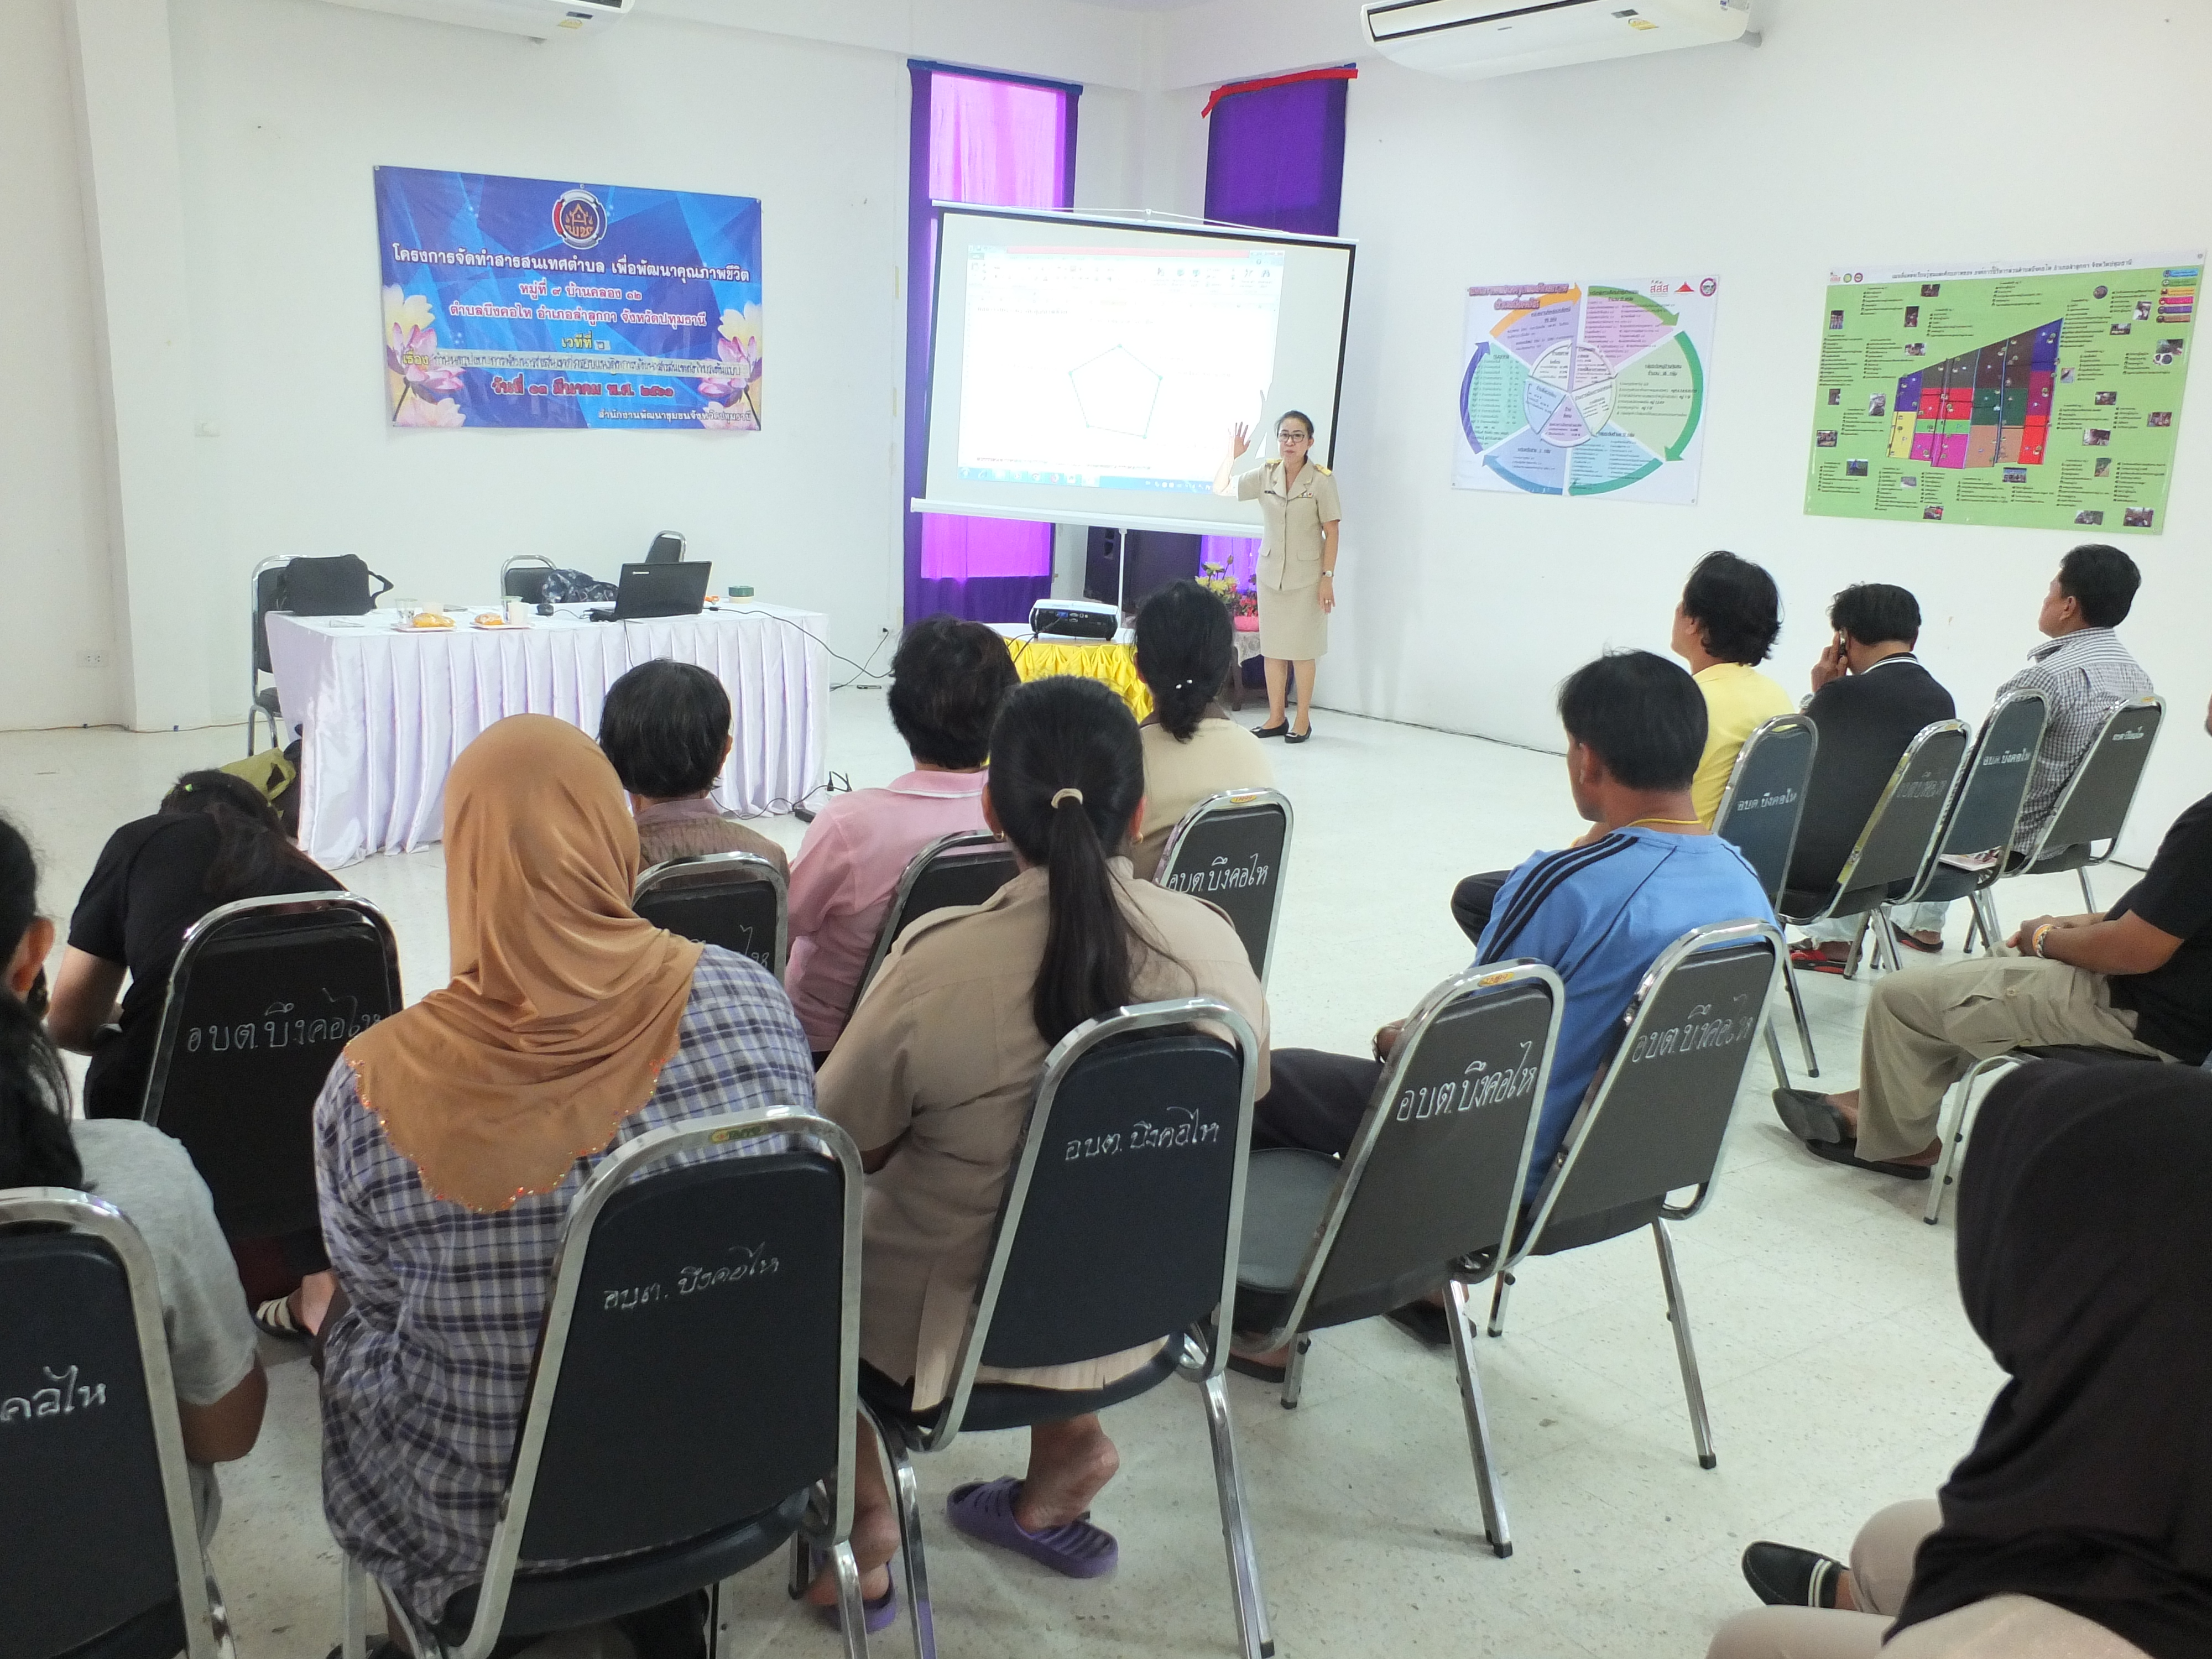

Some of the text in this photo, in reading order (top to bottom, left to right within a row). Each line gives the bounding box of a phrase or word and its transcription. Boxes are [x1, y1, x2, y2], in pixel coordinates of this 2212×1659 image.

[393, 243, 750, 283] โครงการจัดทำสารสนเทศตำบล เพื่อพัฒนาคุณภาพชีวิต
[520, 278, 547, 299] หมู่ที่
[566, 283, 622, 299] บ้านคลอง
[537, 304, 617, 325] อำเภอลำลูกกา
[621, 308, 707, 329] จังหวัดปทุมธานี
[561, 330, 592, 348] เวทีที่
[403, 349, 429, 365] เรื่อง
[492, 373, 524, 394] วันที่
[553, 378, 602, 395] มีนาคม
